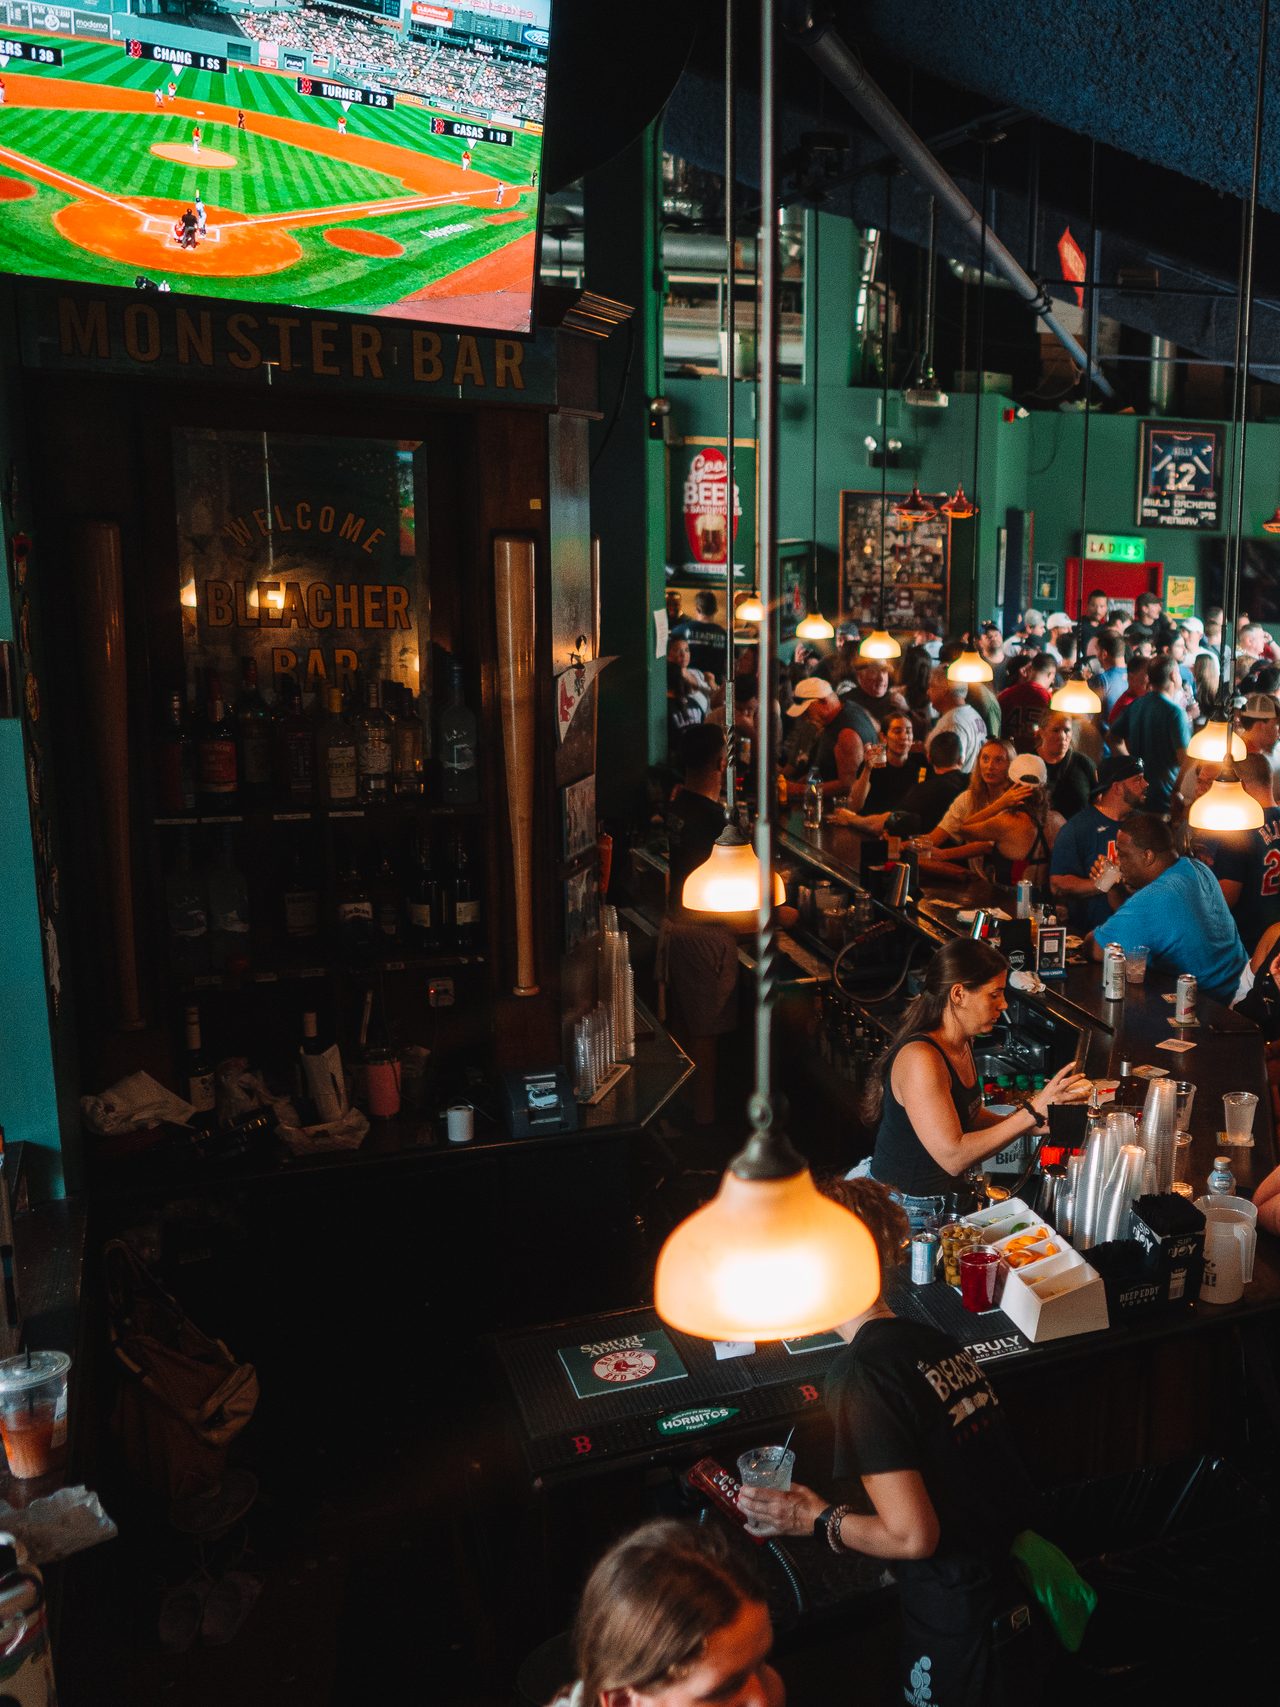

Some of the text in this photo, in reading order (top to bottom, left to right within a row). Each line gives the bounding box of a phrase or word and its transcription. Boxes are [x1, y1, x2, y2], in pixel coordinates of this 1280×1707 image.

[39, 50, 55, 63] 3B
[153, 46, 192, 65] CHANG
[206, 58, 220, 70] SS
[322, 84, 362, 103] TURNER
[375, 95, 388, 107] 2B
[453, 123, 484, 139] CASAS
[496, 132, 507, 143] 1B
[58, 297, 527, 390] MONSTER BAR
[1166, 462, 1197, 492] 12
[1174, 499, 1217, 510] BACKERS
[223, 500, 386, 555] WELCOME
[1160, 515, 1199, 526] FENWAY
[1090, 541, 1142, 556] LADIES
[205, 579, 413, 630] BLEACHER
[271, 647, 360, 694] BAR
[1139, 1222, 1151, 1236] SIP
[1120, 1285, 1160, 1302] DEEP EDDY
[1122, 1296, 1156, 1308] VODKA
[580, 1335, 646, 1353] SAMUEL
[589, 1343, 643, 1358] ADAMS
[963, 1335, 1020, 1356] TRULY
[992, 1345, 1022, 1355] SELTZER
[597, 1352, 646, 1365] BOSTON
[603, 1365, 653, 1381] RED SOX
[662, 1408, 729, 1430] HORNITOS
